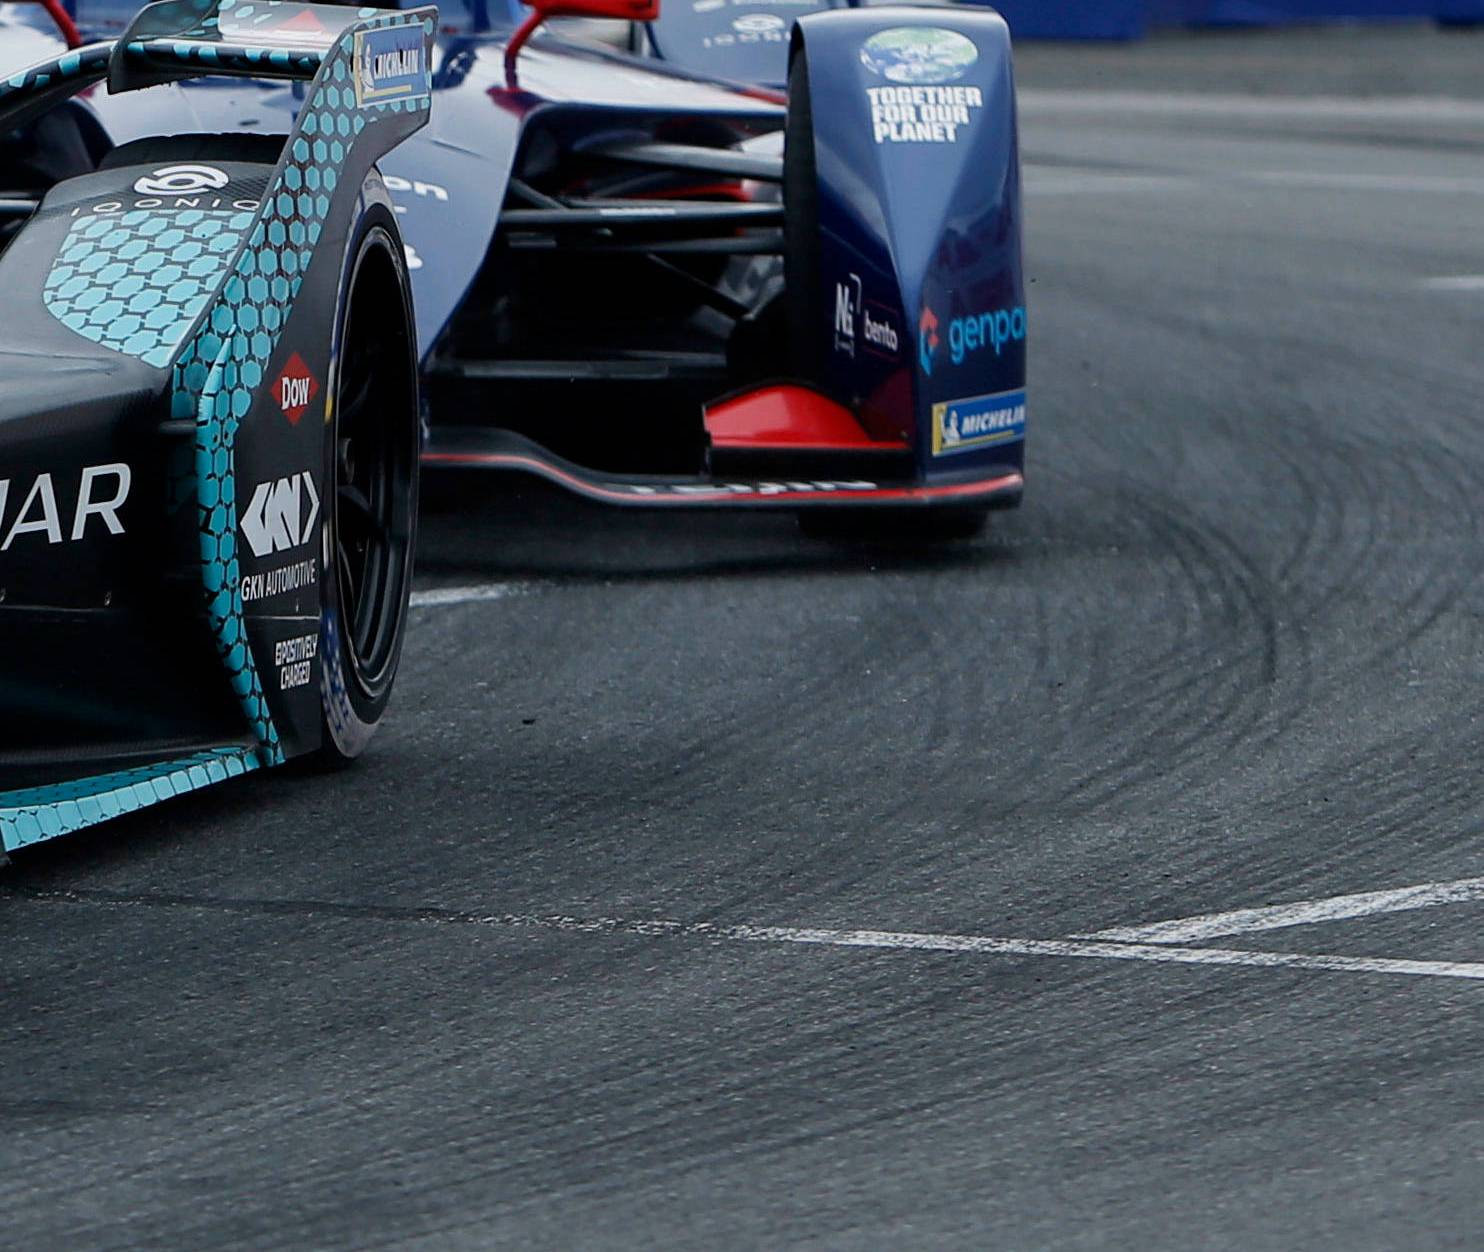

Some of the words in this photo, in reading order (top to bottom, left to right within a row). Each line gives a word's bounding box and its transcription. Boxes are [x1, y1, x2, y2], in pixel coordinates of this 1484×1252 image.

[866, 87, 983, 107] TOGETHER
[872, 105, 917, 123] FOR
[920, 105, 969, 124] OUR
[874, 122, 958, 144] PLANET
[282, 376, 310, 410] DOW
[241, 576, 264, 603] GKN
[265, 557, 316, 597] AUTOMOTIVE
